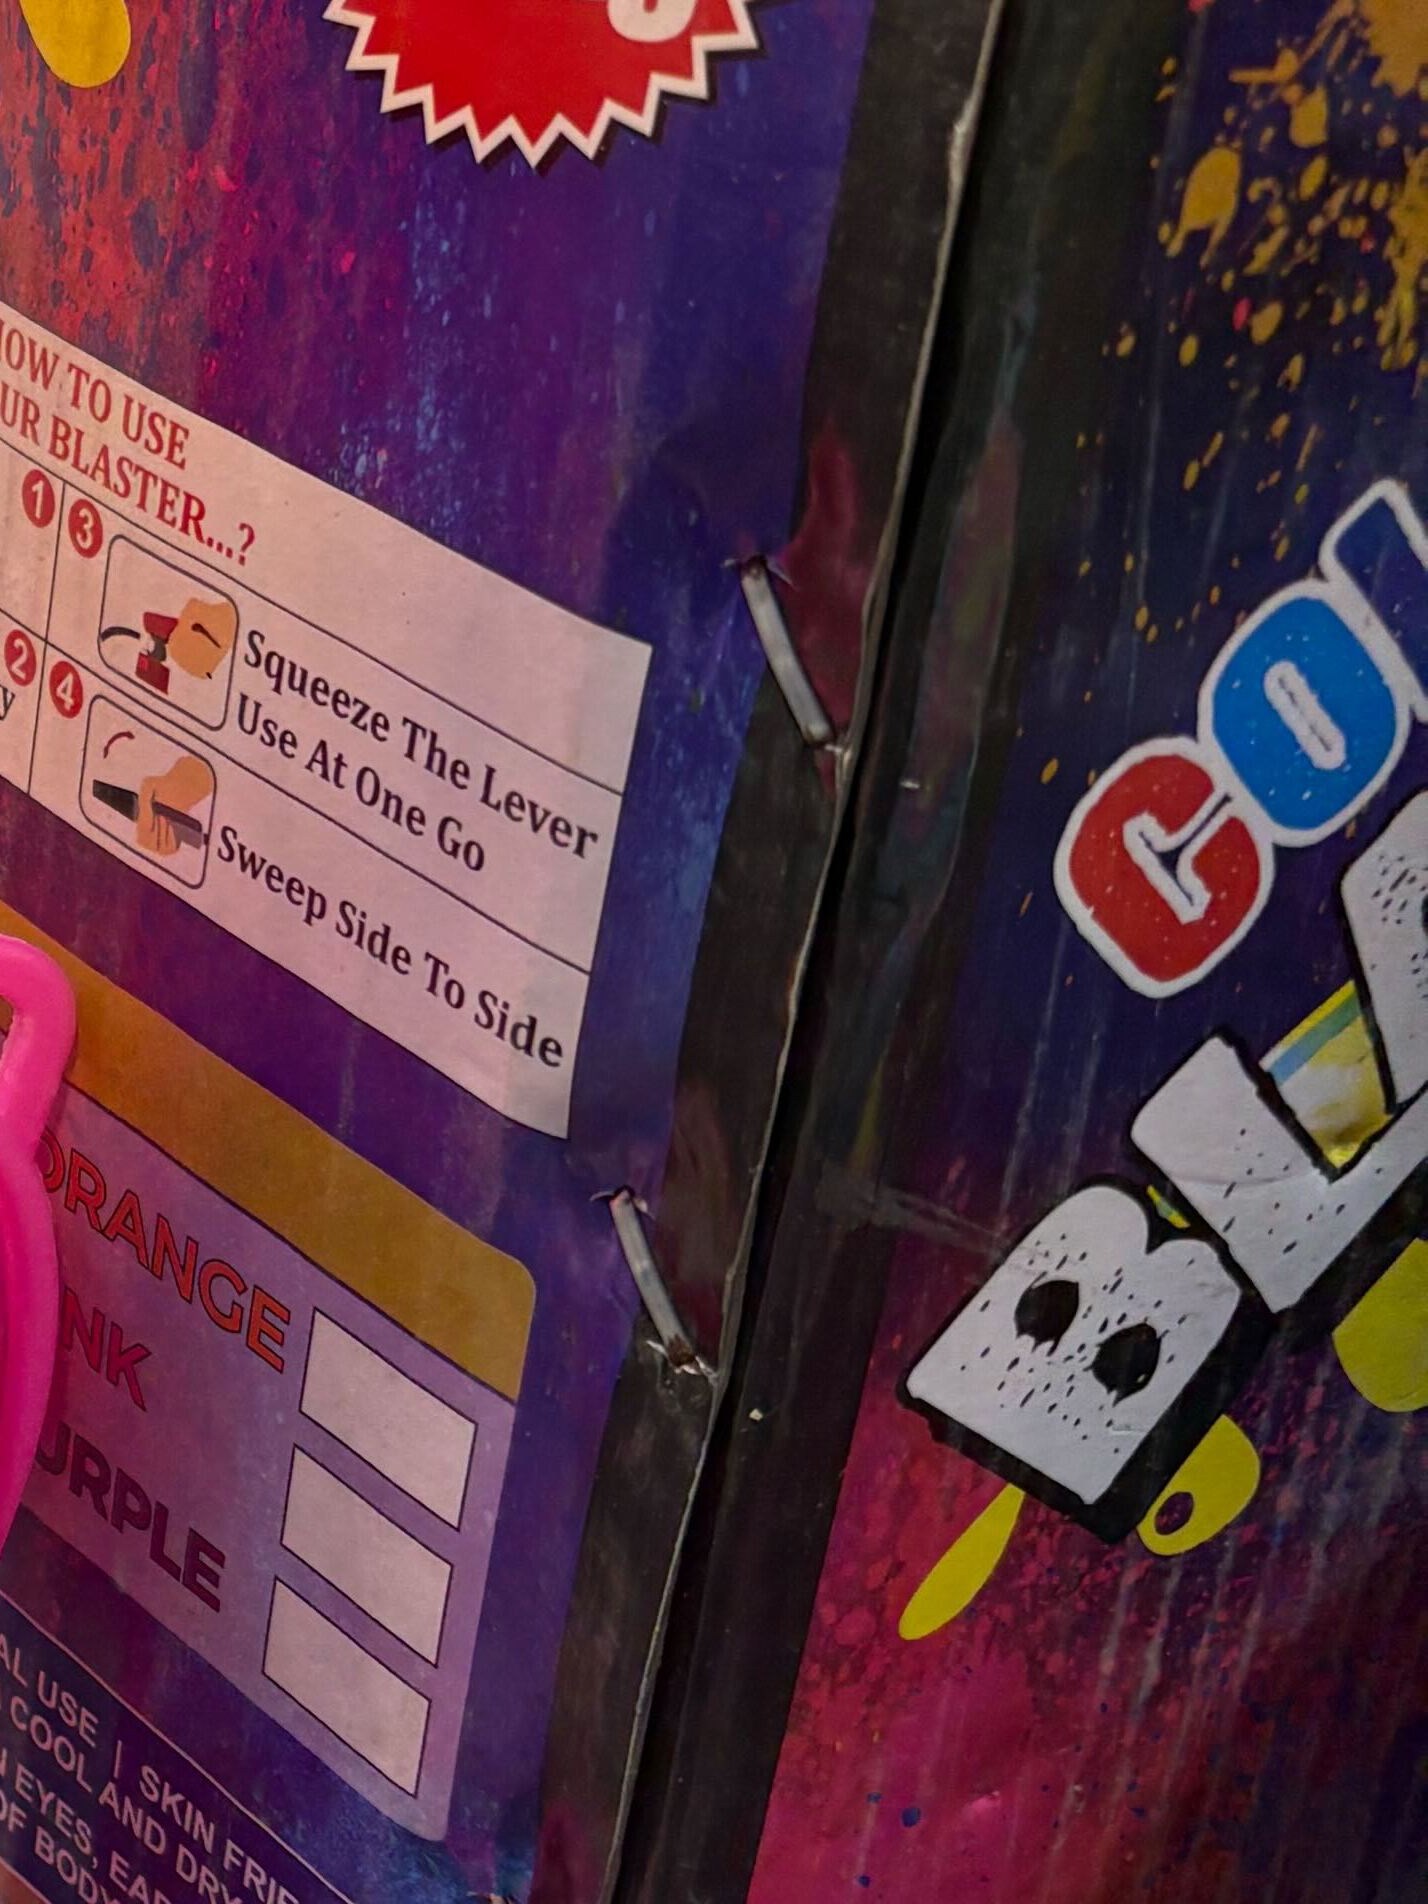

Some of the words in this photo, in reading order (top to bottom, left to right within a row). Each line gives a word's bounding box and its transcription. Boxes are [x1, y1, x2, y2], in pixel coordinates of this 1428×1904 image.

[49, 416, 256, 567] BLASTER...?
[66, 359, 112, 426] TO
[121, 390, 189, 470] USE
[236, 695, 299, 764] Use
[305, 736, 351, 796] At
[355, 765, 428, 840] One
[437, 812, 487, 875] Go
[243, 628, 392, 744] Squeeze
[400, 713, 473, 790] The
[478, 765, 600, 862] Lever
[216, 826, 329, 923] Sweep
[337, 901, 414, 977] Side
[424, 948, 467, 1012] To
[477, 990, 564, 1073] Side
[39, 1126, 292, 1376] ORANGE
[59, 1286, 152, 1413] NK
[34, 1418, 226, 1613] URPLE
[9, 1694, 93, 1794] COOL
[98, 1783, 167, 1856] AND
[14, 1763, 98, 1866] EYES,
[37, 1670, 100, 1749] USE
[139, 1763, 215, 1851] SKIN
